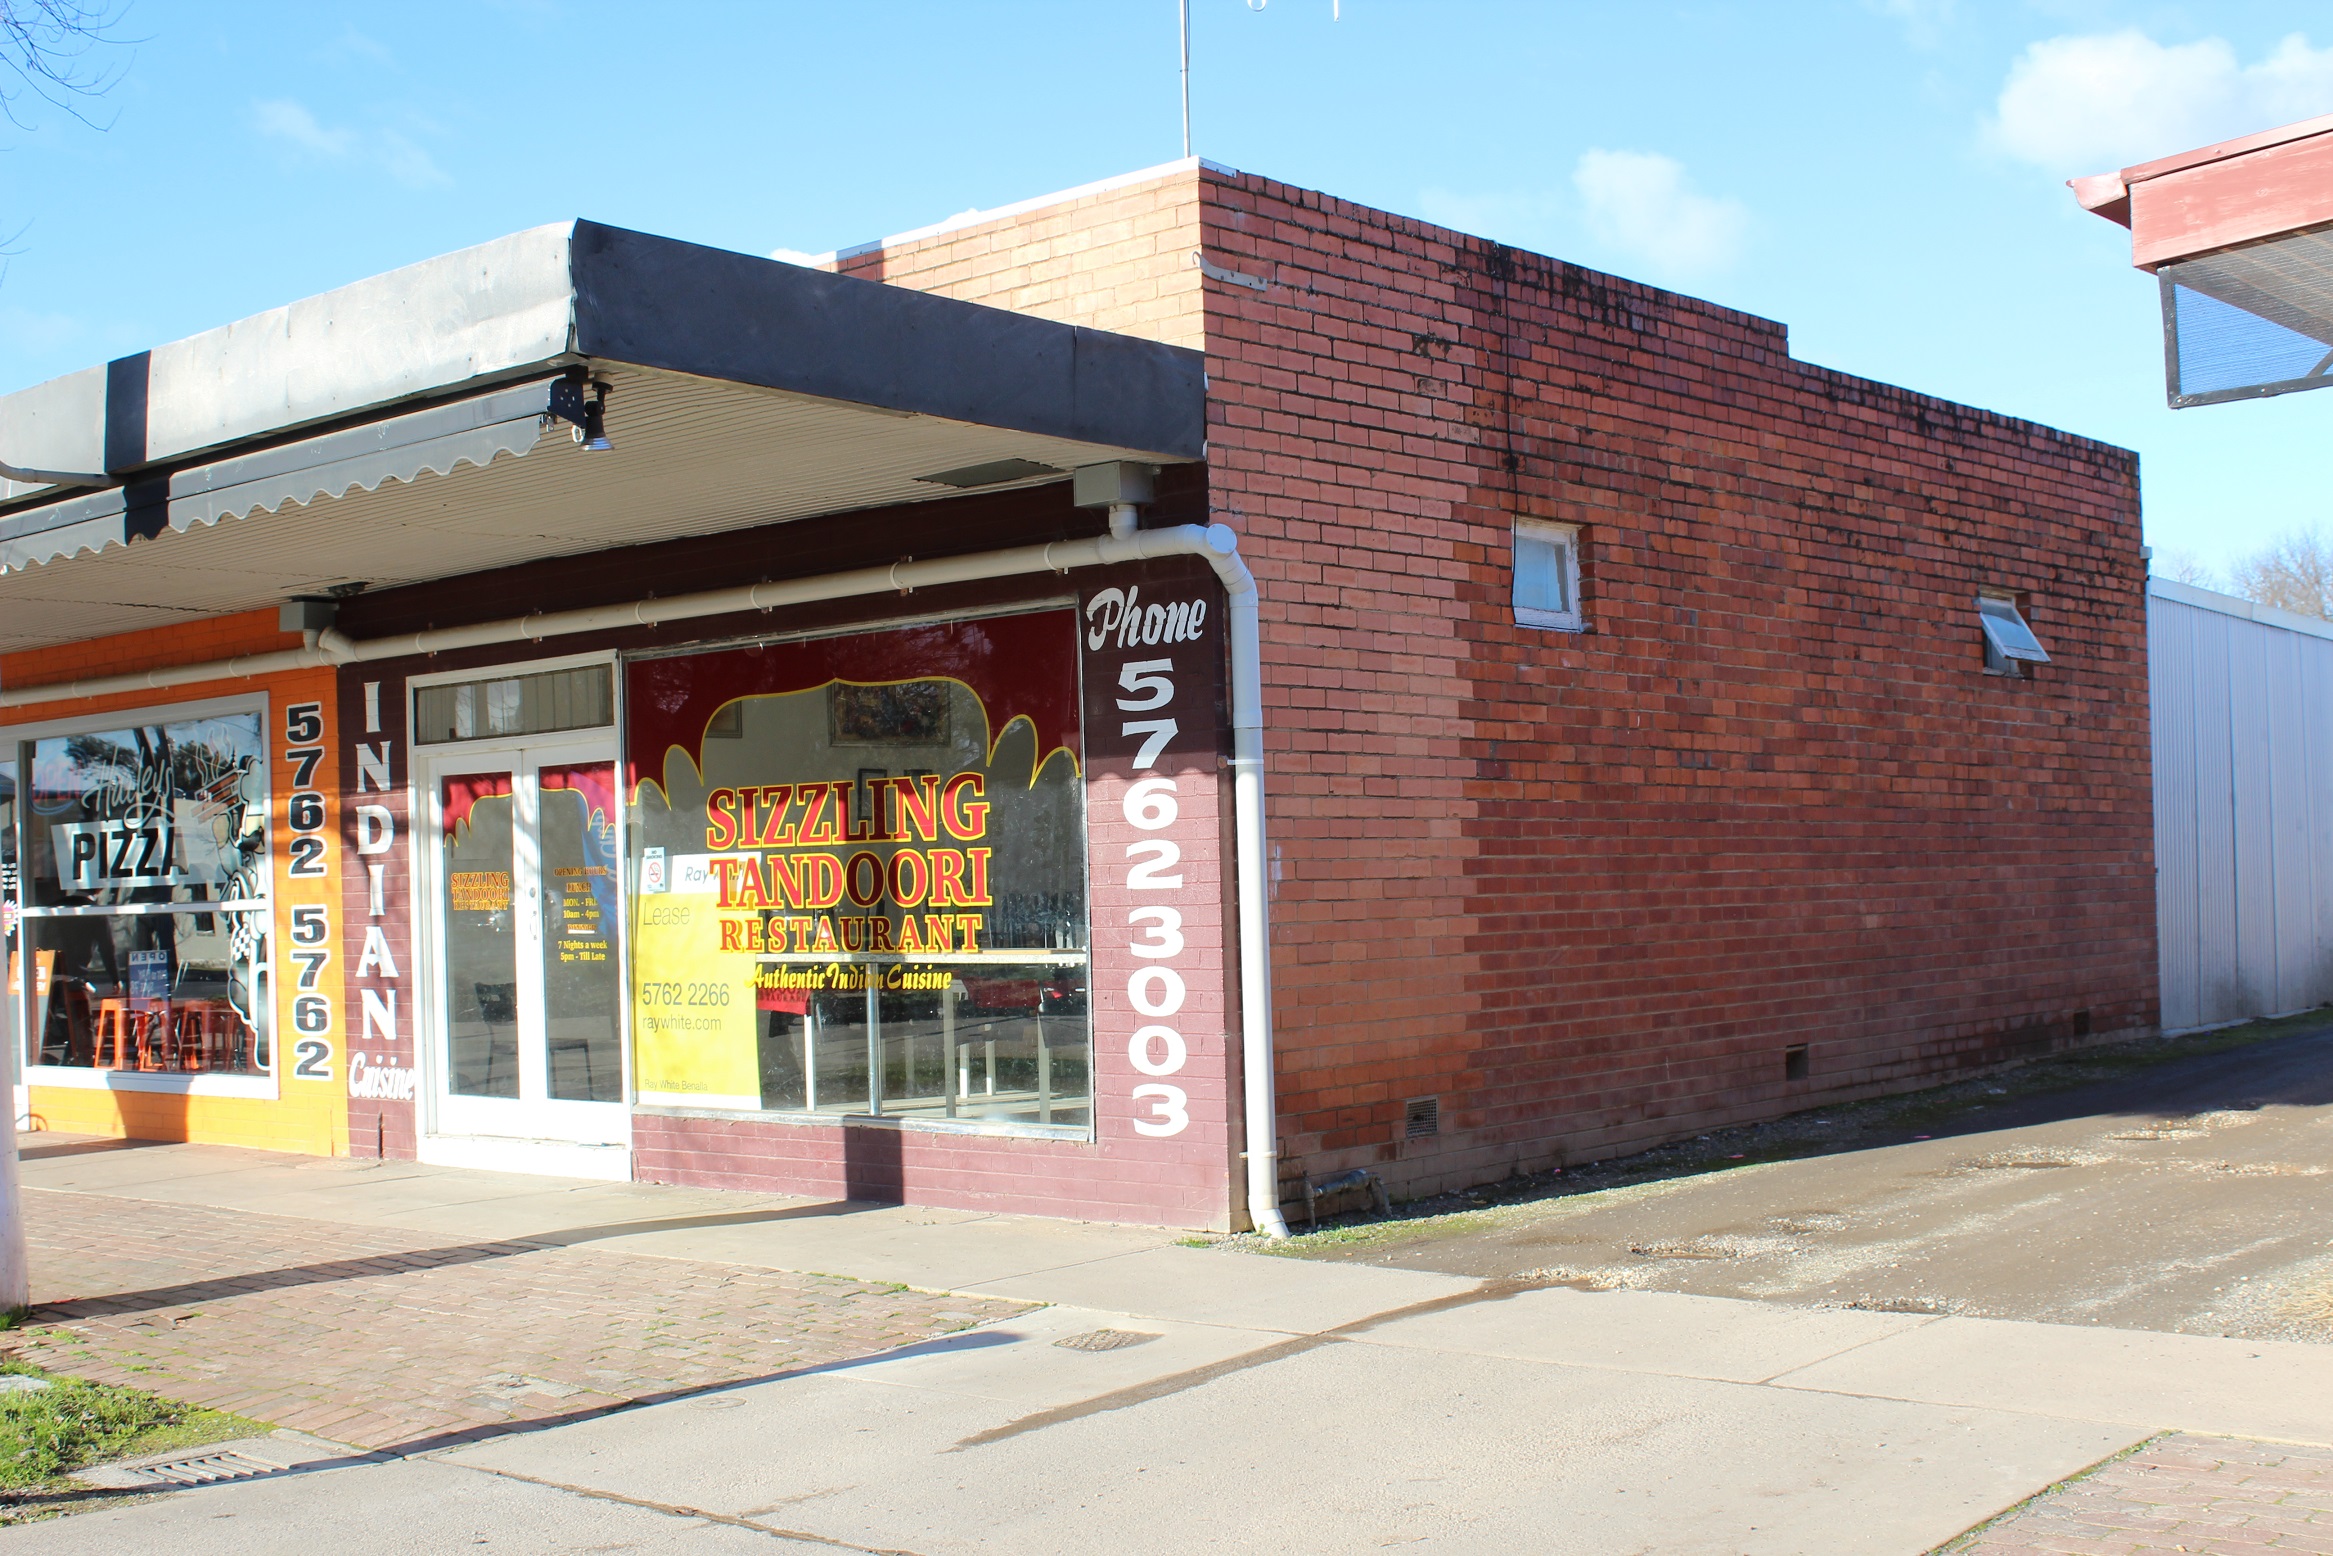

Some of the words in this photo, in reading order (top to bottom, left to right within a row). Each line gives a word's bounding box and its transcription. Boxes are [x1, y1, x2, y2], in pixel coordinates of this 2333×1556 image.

[1087, 584, 1207, 652] Phone
[286, 701, 328, 878] 5762
[706, 771, 991, 851] SIZZLING
[72, 827, 189, 880] PIZZA
[355, 681, 399, 1041] INDIAN
[451, 871, 509, 888] SIZZLING
[554, 867, 582, 876] OPENING
[584, 866, 608, 875] HOURS
[685, 866, 708, 884] Ray
[709, 847, 993, 910] TANDOORI
[452, 888, 509, 901] TANDOORI
[566, 882, 592, 892] LUNCH
[563, 910, 580, 918] 10am
[585, 910, 599, 920] 4pm
[643, 902, 690, 925] Lease
[719, 913, 983, 953] RESTAURANT
[558, 940, 562, 949] 7
[564, 940, 584, 951] Nights
[591, 940, 608, 949] week
[560, 952, 574, 962] 5pm
[579, 952, 590, 960] Till
[591, 952, 605, 960] Late
[744, 963, 825, 989] Authentic
[826, 963, 884, 990] Indian
[887, 964, 952, 990] Cuisine
[290, 904, 333, 1081] 5762
[642, 982, 682, 1005] 5762
[688, 982, 730, 1006] 2266
[643, 1014, 722, 1033] raywhite.com
[349, 1051, 415, 1101] Cuisine
[645, 1079, 657, 1090] Ray
[660, 1080, 679, 1090] White
[682, 1081, 708, 1091] Benalla
